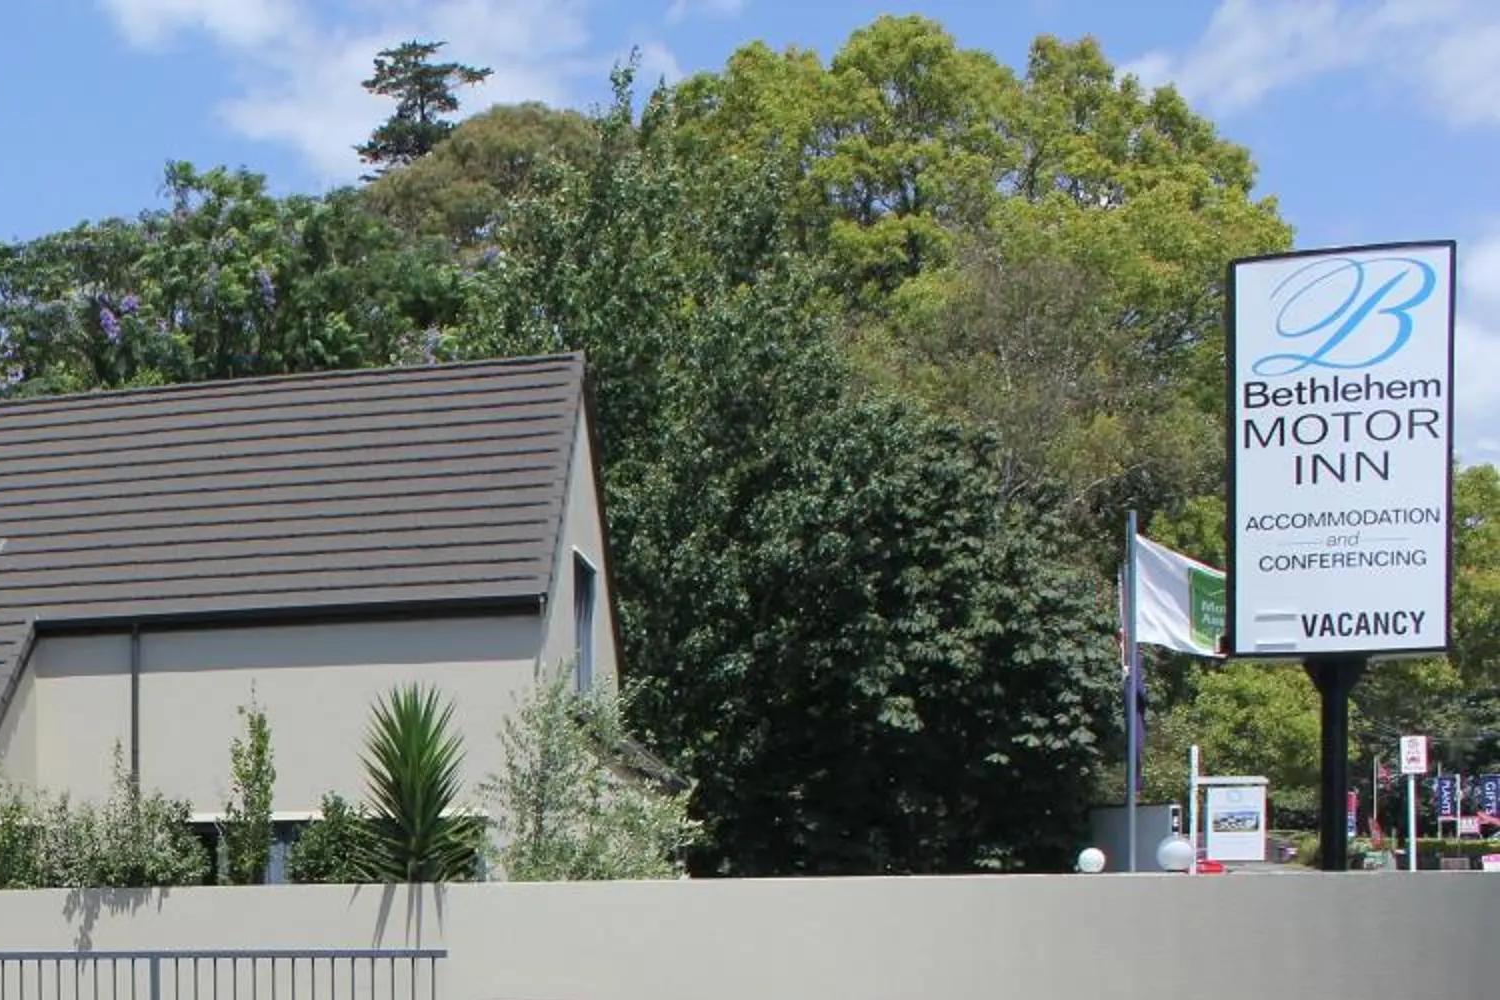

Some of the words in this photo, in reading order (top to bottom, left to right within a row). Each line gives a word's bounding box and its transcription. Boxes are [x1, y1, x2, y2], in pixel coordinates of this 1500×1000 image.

[1244, 373, 1441, 409] Bethlehem
[1244, 408, 1440, 449] MOTOR
[1295, 450, 1390, 485] INN
[1245, 507, 1441, 532] ACCOMMODATION
[1326, 530, 1360, 547] and
[1259, 549, 1427, 572] CONFERENCING
[1301, 610, 1425, 638] VACANCY
[1485, 781, 1497, 815] GIFTS
